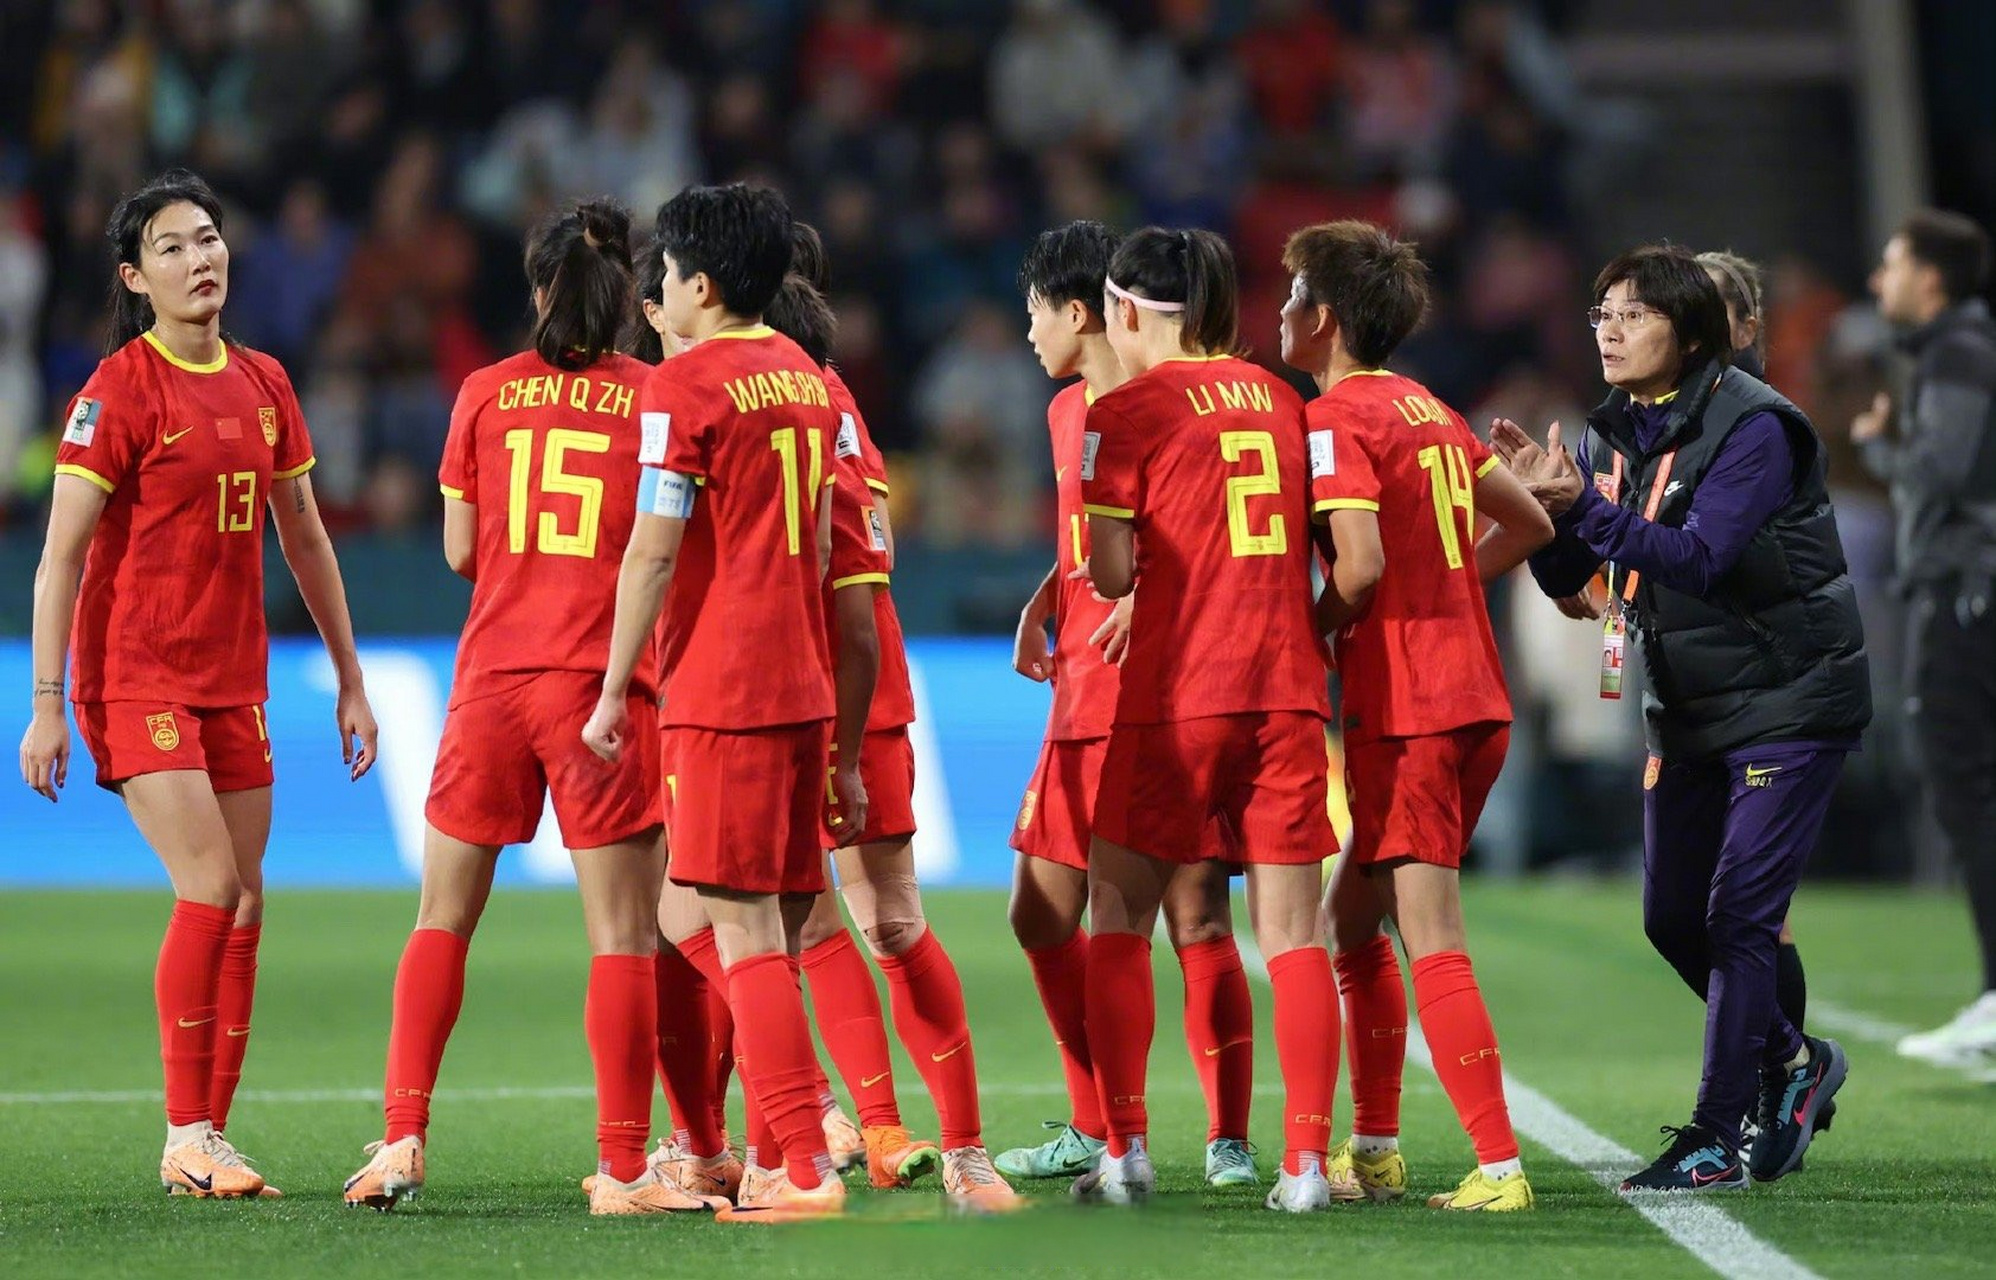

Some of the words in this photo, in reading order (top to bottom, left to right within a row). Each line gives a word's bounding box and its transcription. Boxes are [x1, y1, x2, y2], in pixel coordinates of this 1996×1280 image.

[498, 373, 564, 411] CHEN
[569, 377, 591, 413] Q
[594, 381, 635, 419] ZH
[1185, 384, 1217, 416] LI
[1214, 380, 1274, 413] MW
[216, 470, 257, 534] 13
[505, 428, 611, 559] 15
[663, 480, 682, 491] FIFA
[770, 427, 823, 557] 11
[1219, 431, 1288, 558] 2
[1417, 444, 1475, 570] 14
